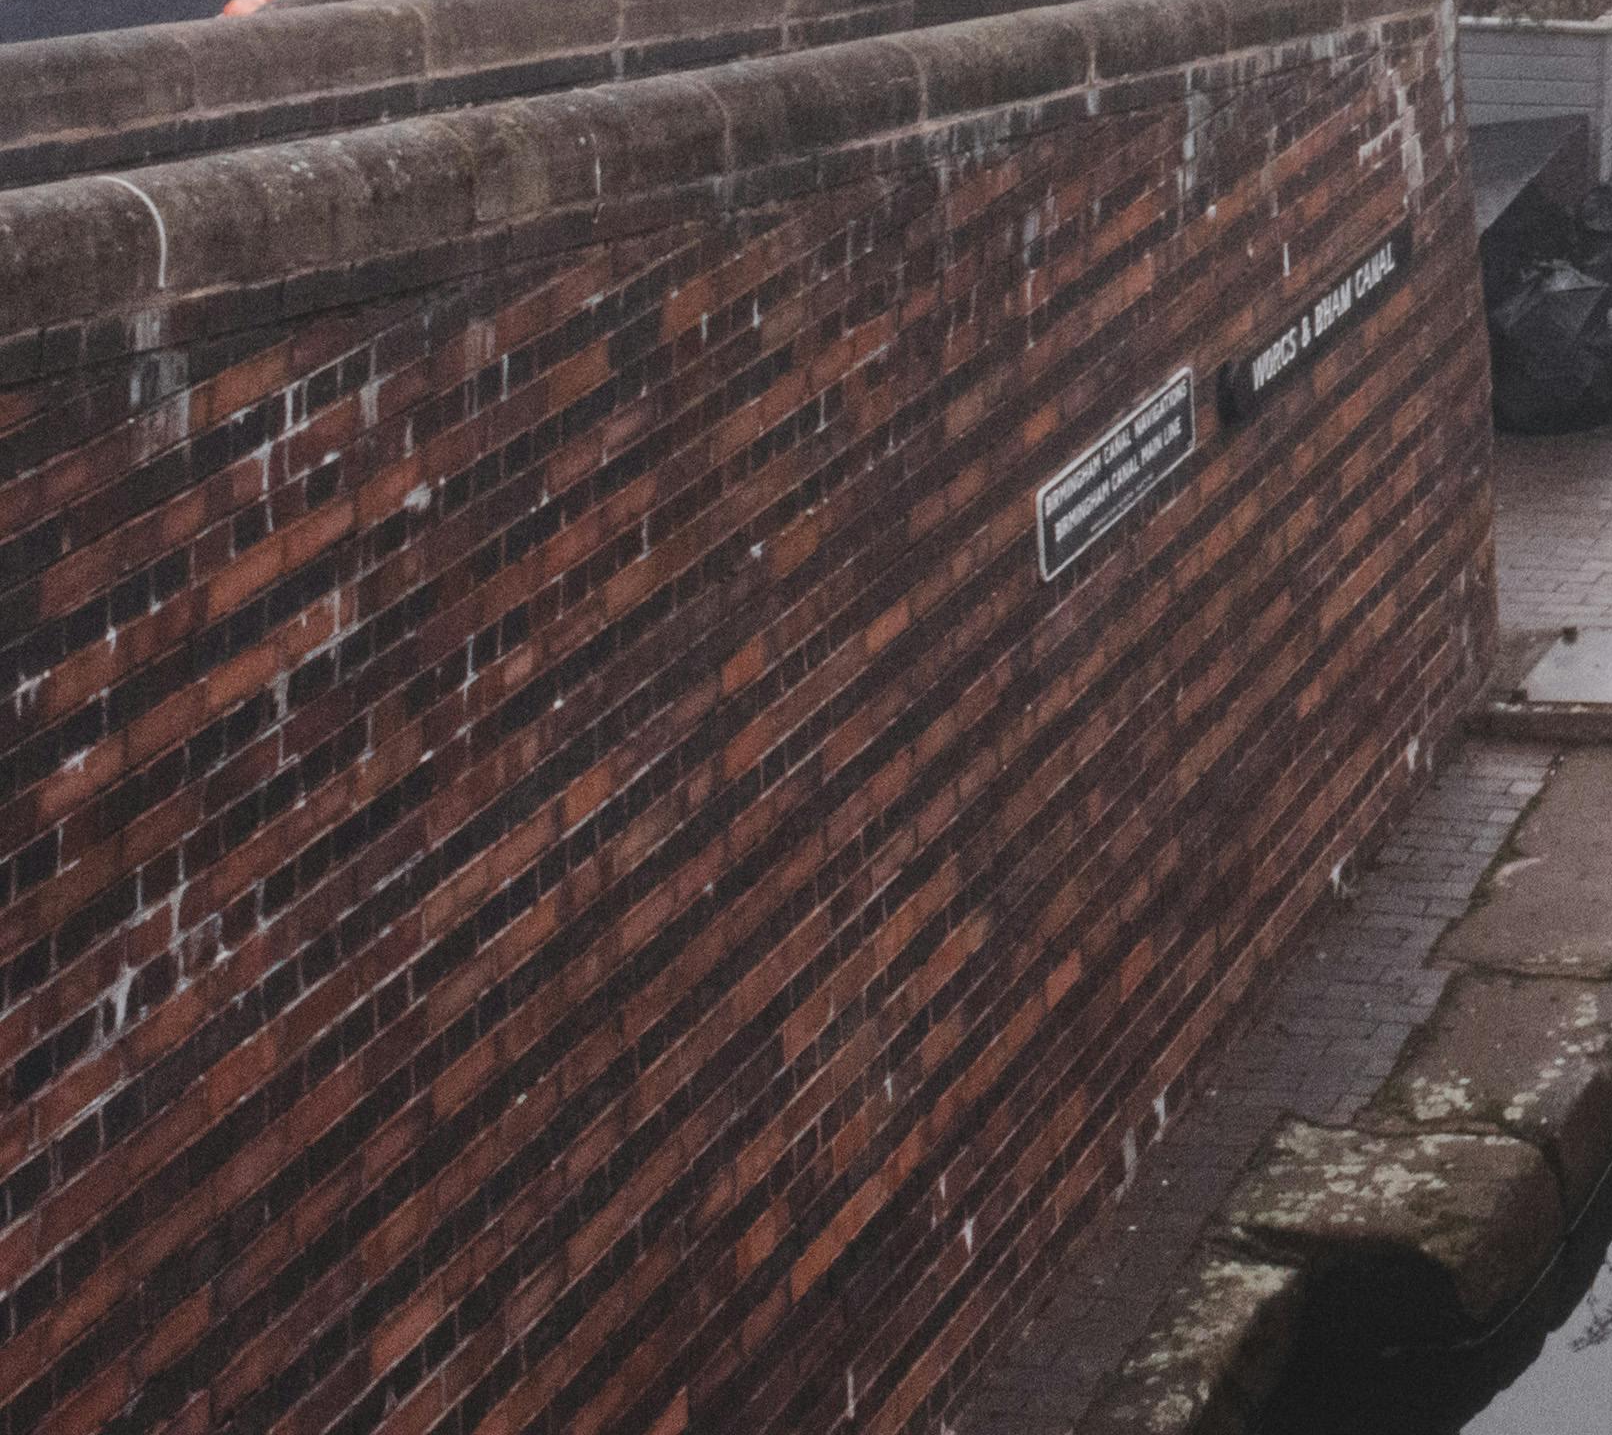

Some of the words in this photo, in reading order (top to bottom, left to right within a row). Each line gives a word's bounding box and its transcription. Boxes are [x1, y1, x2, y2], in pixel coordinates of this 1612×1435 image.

[1252, 325, 1297, 391] WORCS
[1301, 315, 1311, 348] &
[1355, 242, 1396, 299] CANAL
[1044, 452, 1101, 517] BIRMINGHAM
[1103, 427, 1132, 465] CANAL
[1055, 478, 1110, 543] BIRMINGHAM
[1111, 453, 1140, 492] CANAL
[1140, 432, 1163, 467] MAIN
